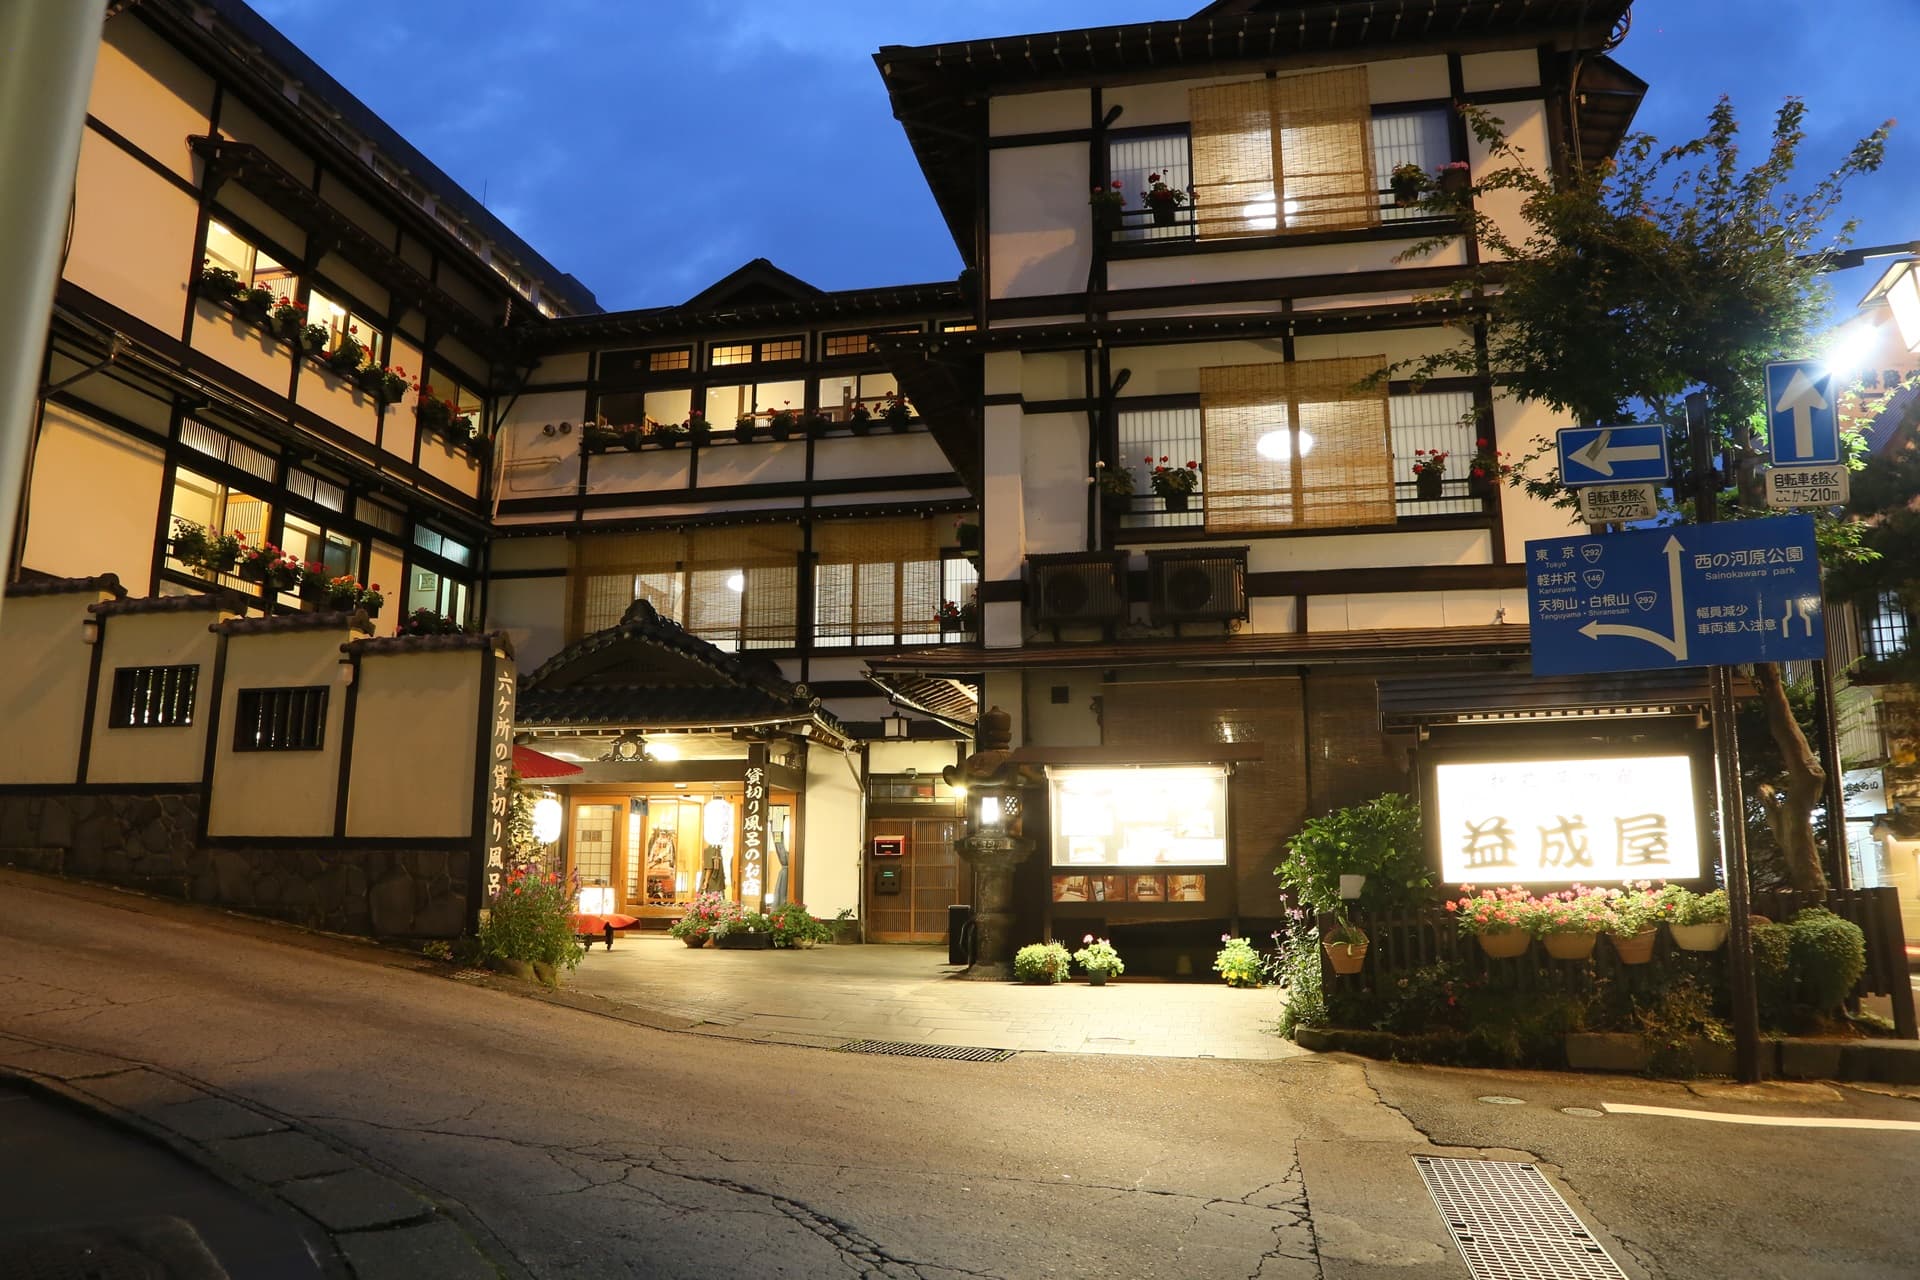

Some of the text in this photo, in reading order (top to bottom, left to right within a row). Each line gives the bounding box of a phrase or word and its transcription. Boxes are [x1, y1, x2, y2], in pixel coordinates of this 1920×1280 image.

[1774, 471, 1839, 487] 自転車を除く
[1587, 489, 1647, 505] 自転車を除く
[1775, 487, 1840, 502] ここから210m
[1694, 546, 1803, 569] 西の河原公園
[1537, 571, 1577, 586] 軽井沢
[1705, 566, 1796, 580] Sainokawara park
[1696, 604, 1749, 619] 幅員減少
[1697, 618, 1777, 634] 車両進入注意
[1461, 813, 1671, 870] 益成屋
